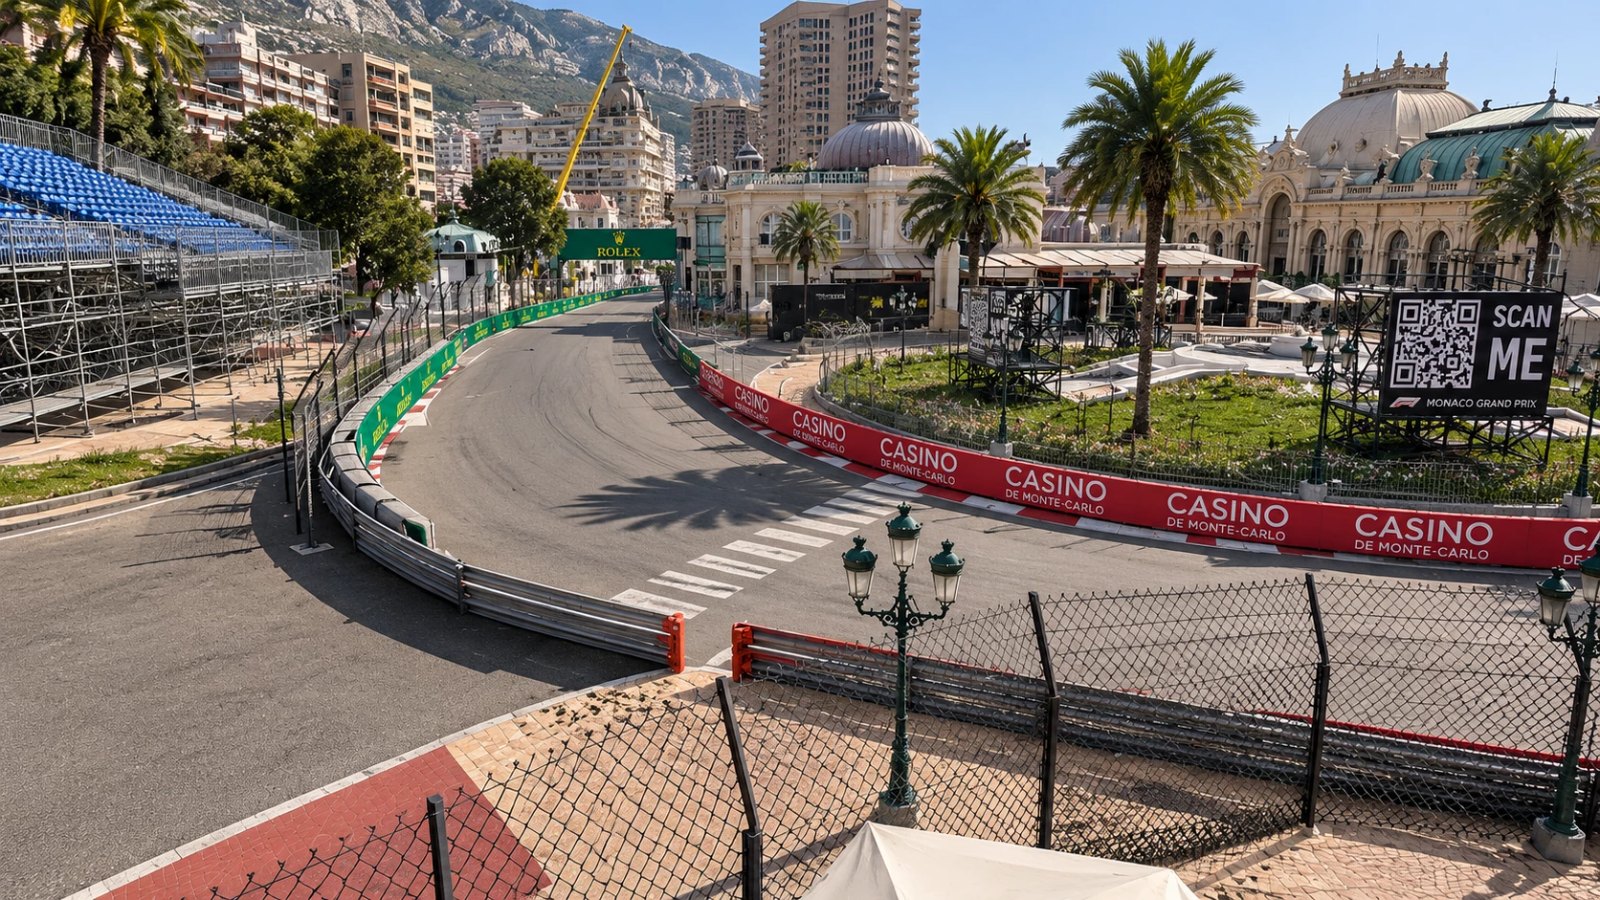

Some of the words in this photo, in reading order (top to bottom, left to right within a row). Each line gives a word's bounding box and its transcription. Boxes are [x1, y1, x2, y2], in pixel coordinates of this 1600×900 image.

[597, 247, 641, 257] ROLEX
[1492, 305, 1553, 328] SCAN
[1487, 337, 1548, 381] ME
[735, 386, 769, 413] CASINO
[1426, 398, 1474, 408] MONACO
[1476, 399, 1512, 408] GRAND
[1514, 399, 1538, 408] PRIX
[793, 410, 846, 442] CASINO
[880, 438, 958, 473] CASINO
[880, 458, 892, 469] DE
[893, 461, 955, 485] MONTE-CARLO
[1005, 466, 1107, 502] CASINO
[1005, 488, 1019, 500] DE
[1022, 492, 1104, 515] MONTE-CARLO
[1167, 492, 1289, 528] CASINO
[1167, 517, 1183, 528] DE
[1188, 520, 1286, 542] MONTE-CARLO
[1355, 513, 1494, 546] CASINO
[1355, 540, 1374, 551] DE
[1379, 542, 1489, 560] MONTE-CARLO
[1563, 554, 1583, 565] DE
